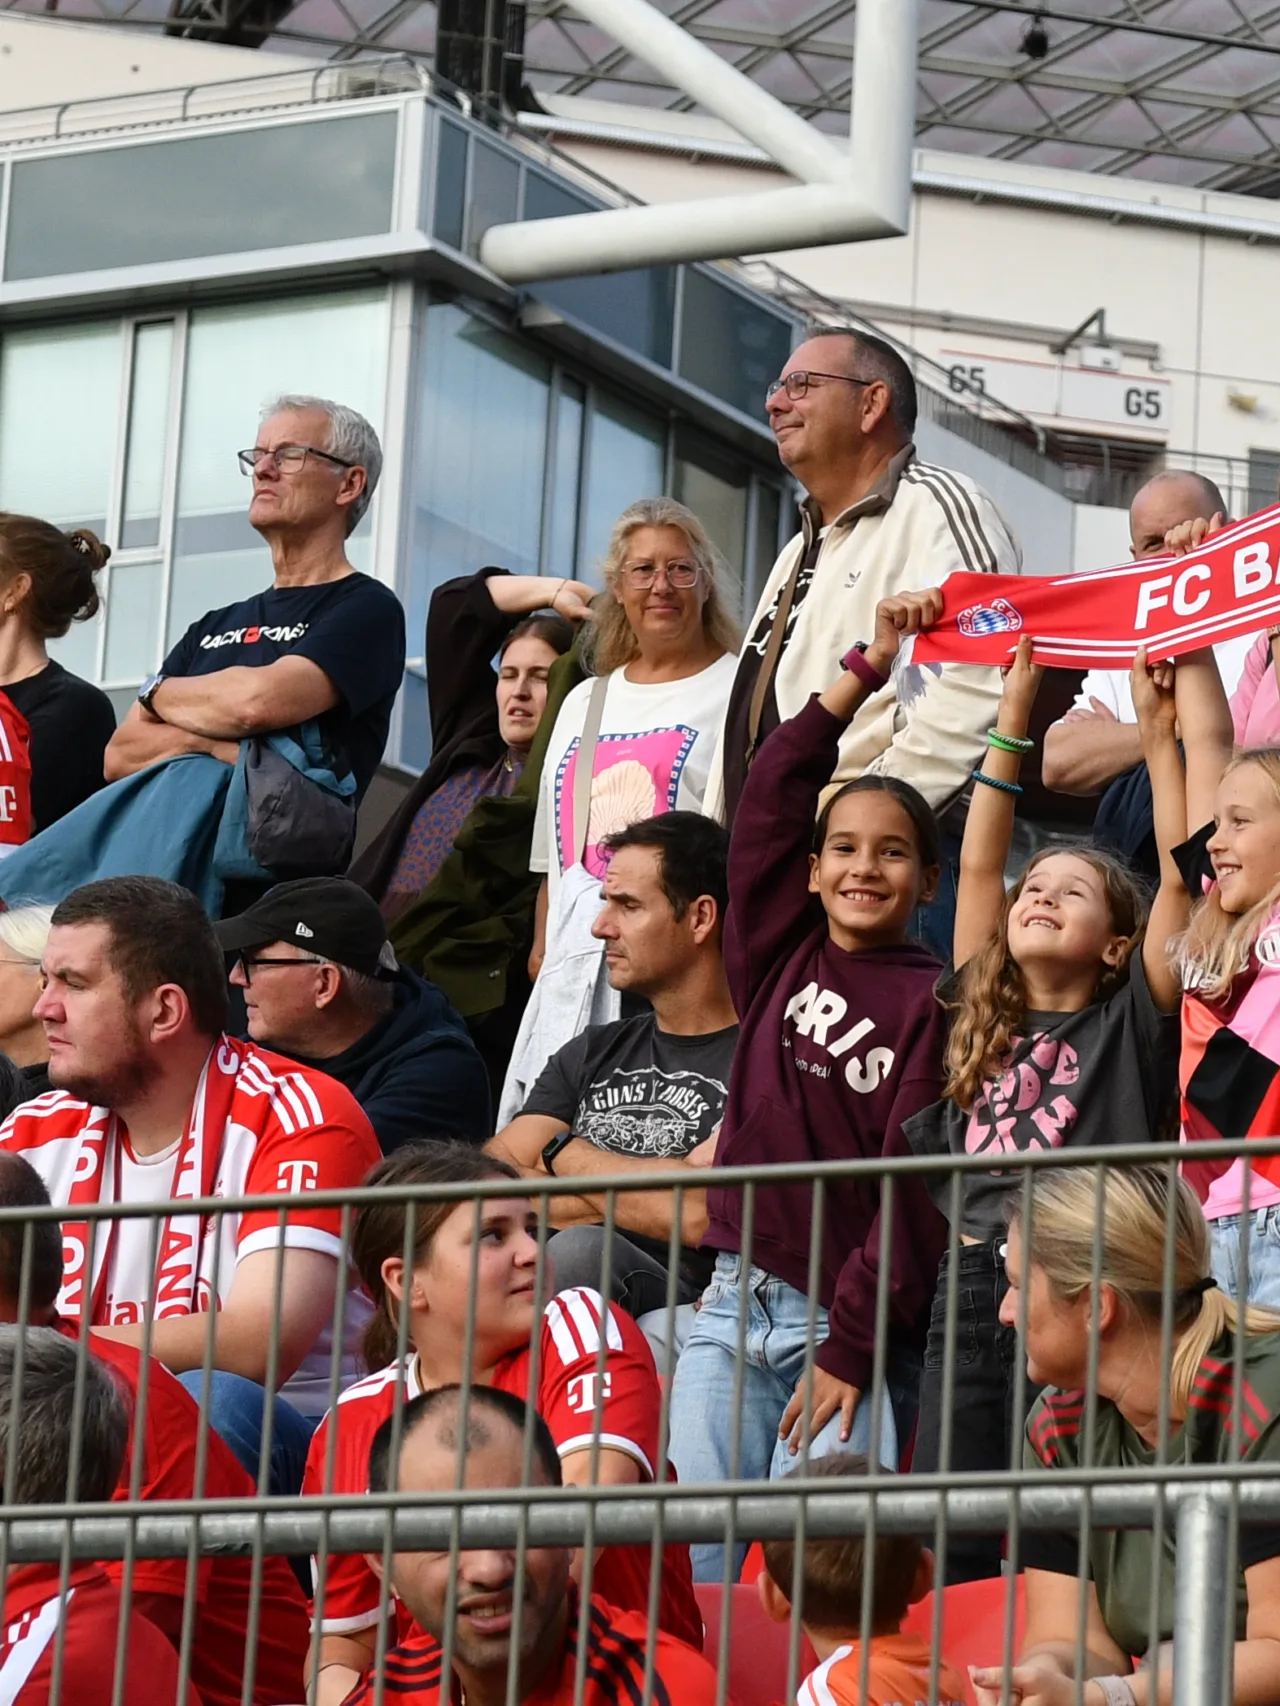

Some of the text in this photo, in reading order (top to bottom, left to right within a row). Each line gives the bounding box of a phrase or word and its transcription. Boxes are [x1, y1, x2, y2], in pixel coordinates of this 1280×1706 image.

[1124, 387, 1162, 419] G5
[1134, 563, 1212, 631] FC
[784, 981, 895, 1094] ARIS
[593, 1082, 647, 1111] GUNS
[659, 1084, 711, 1121] ROSES
[277, 1160, 319, 1195] T
[566, 1371, 612, 1415] T
